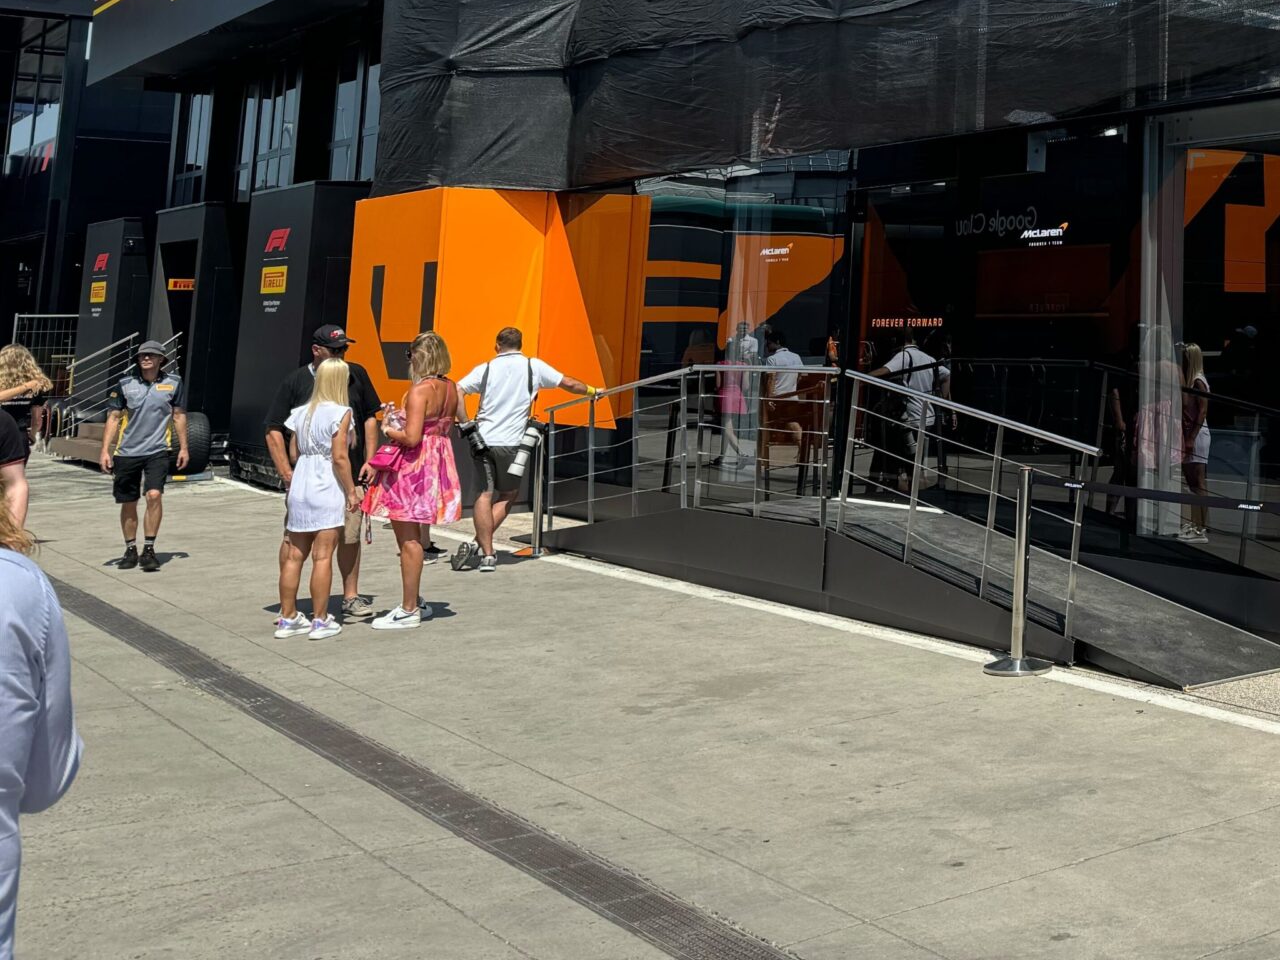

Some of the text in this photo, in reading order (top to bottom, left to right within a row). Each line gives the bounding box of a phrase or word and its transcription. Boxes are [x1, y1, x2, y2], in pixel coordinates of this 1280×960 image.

[1020, 228, 1063, 239] McLaren
[263, 272, 285, 289] PIRELLI
[871, 317, 943, 328] FOREVER FORWARD
